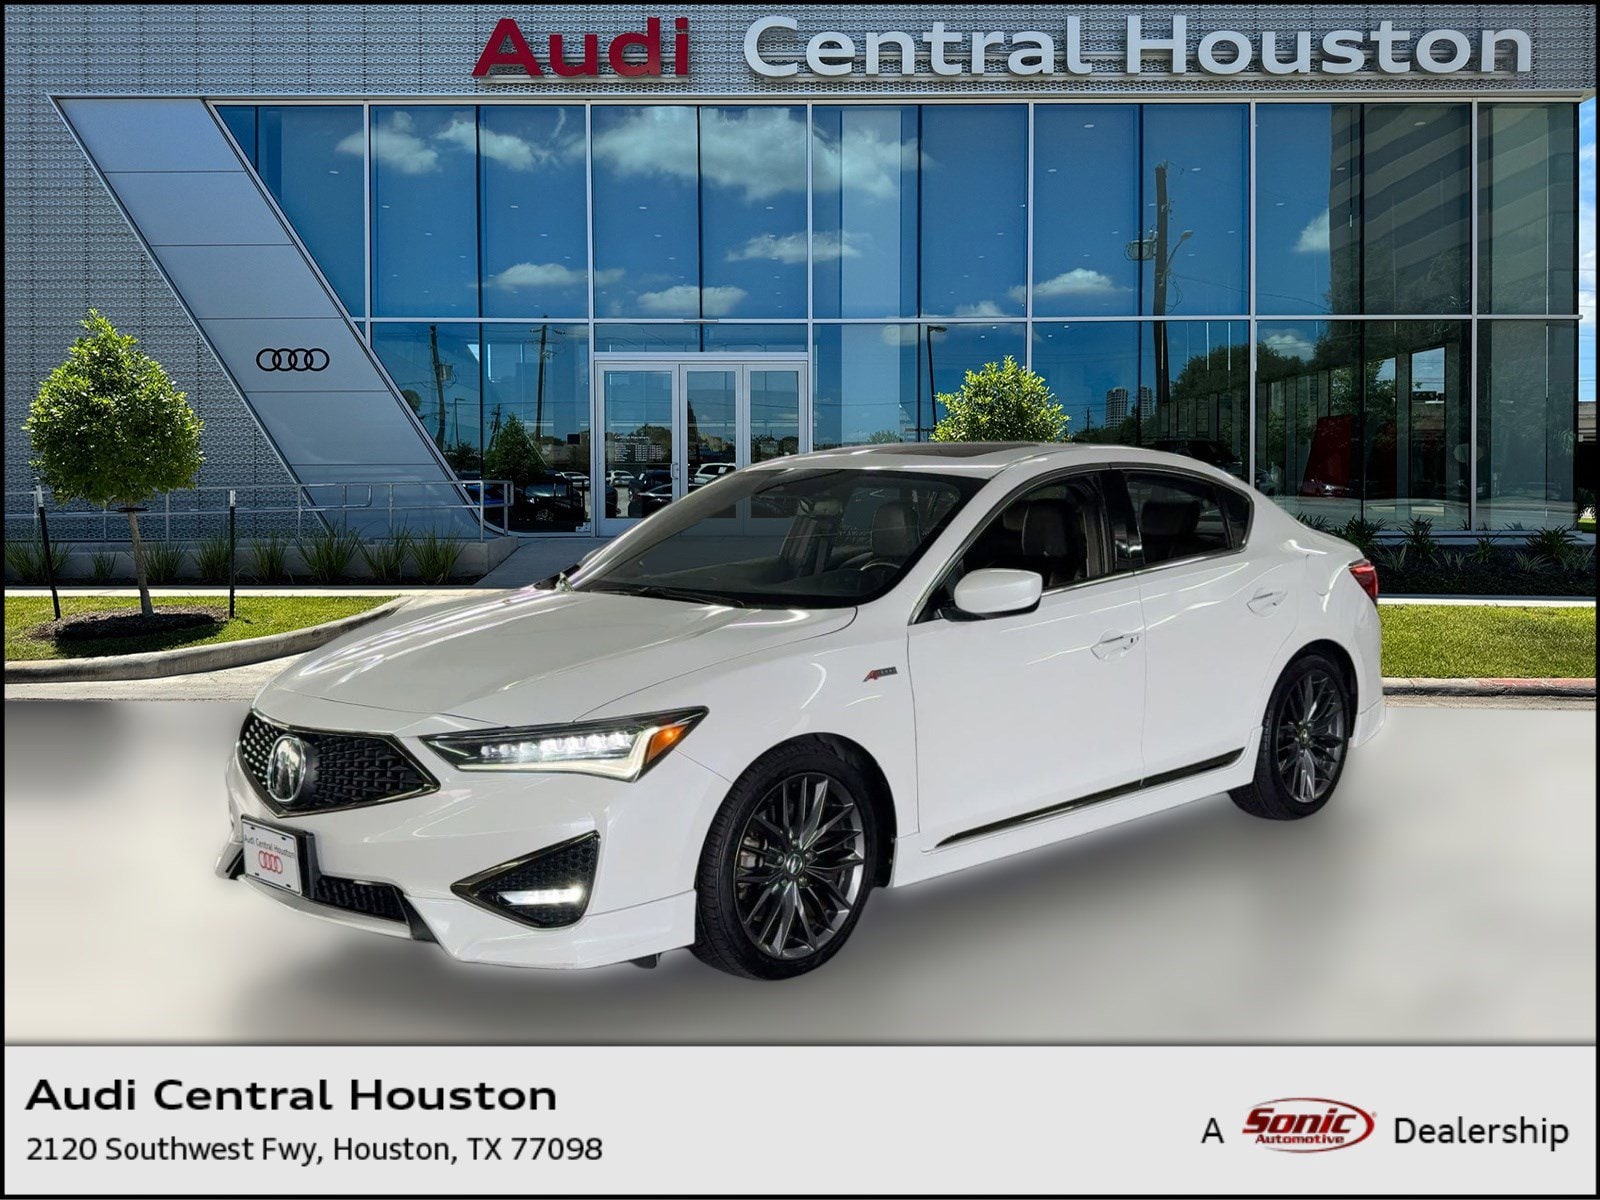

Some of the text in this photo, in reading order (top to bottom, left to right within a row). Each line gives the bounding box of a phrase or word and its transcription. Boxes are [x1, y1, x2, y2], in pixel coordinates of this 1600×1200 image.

[472, 14, 1532, 77] Audi Central Houston
[255, 837, 273, 851] Central
